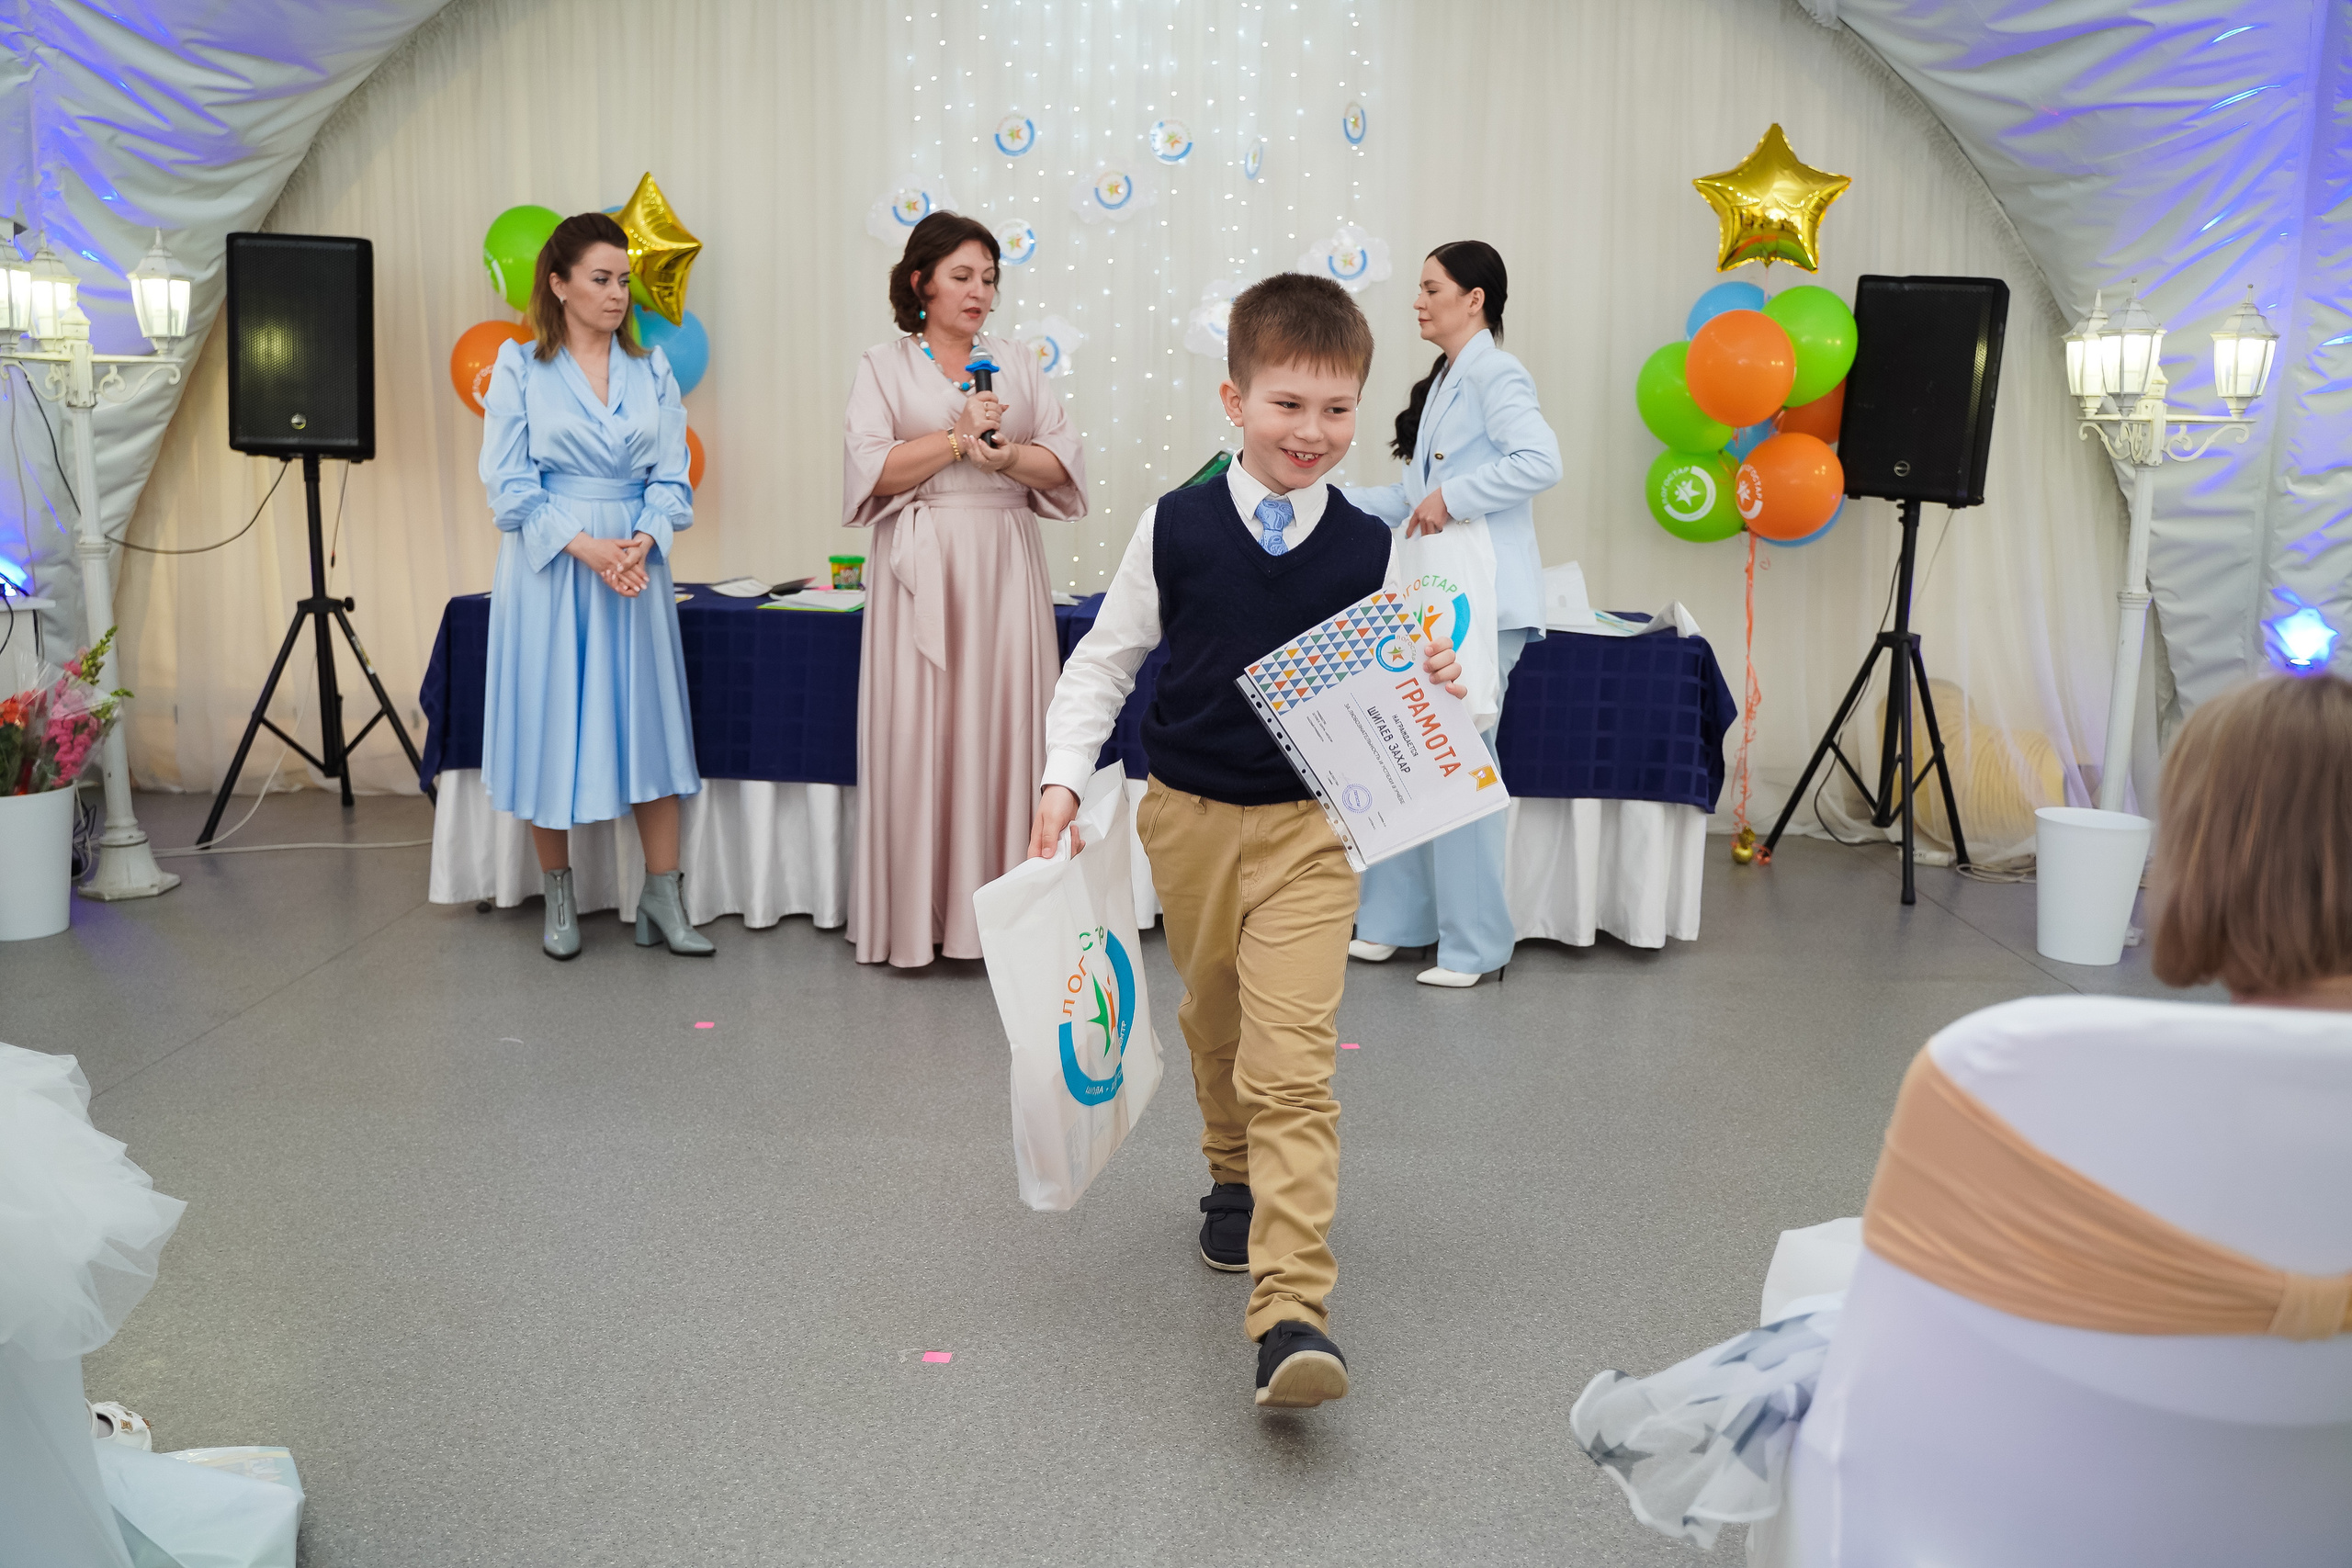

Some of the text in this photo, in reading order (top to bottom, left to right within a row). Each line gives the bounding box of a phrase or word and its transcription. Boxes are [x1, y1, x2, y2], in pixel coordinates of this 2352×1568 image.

[1403, 574, 1458, 600] ГОСТАР
[1366, 706, 1411, 773] ШИГАЕВ ЗАХАР
[1391, 714, 1419, 758] НАГРАЖДАЕТСЯ
[1396, 678, 1461, 776] ГРАМОТА
